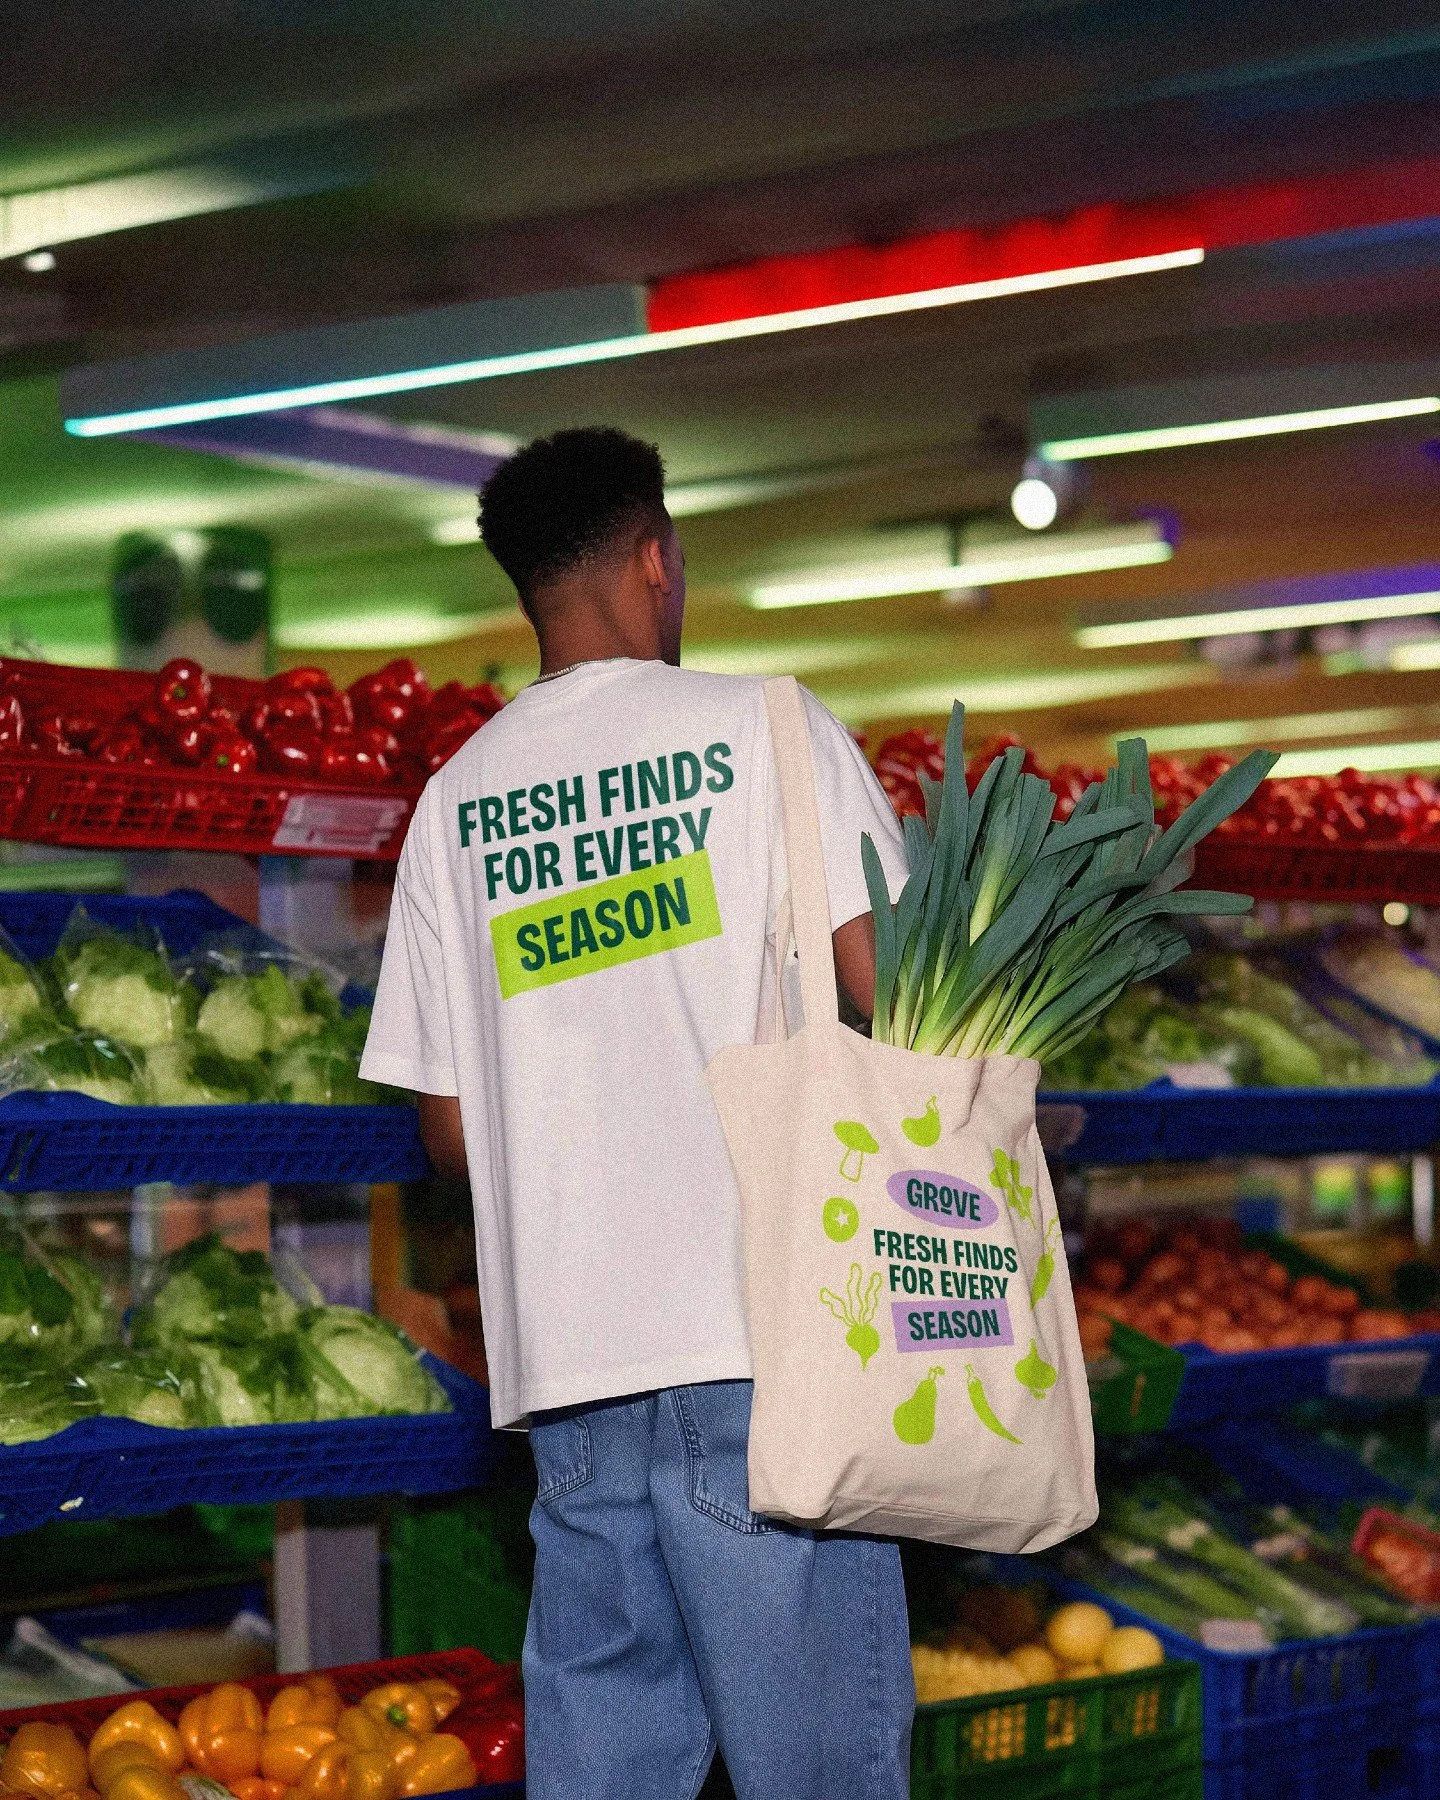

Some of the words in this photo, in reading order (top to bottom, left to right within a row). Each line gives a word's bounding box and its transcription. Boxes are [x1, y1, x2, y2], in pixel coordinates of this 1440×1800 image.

[458, 775, 587, 848] FRESH
[598, 742, 735, 818] FINDS
[484, 842, 563, 900] FOR
[574, 807, 713, 882] EVERY
[516, 877, 692, 972] SEASON
[906, 1178, 982, 1222] GROVE
[873, 1228, 948, 1265] FRESH
[953, 1240, 1018, 1273] FINDS
[889, 1264, 935, 1296] FOR
[940, 1270, 1009, 1300] EVERY
[907, 1309, 1001, 1341] SEASON
